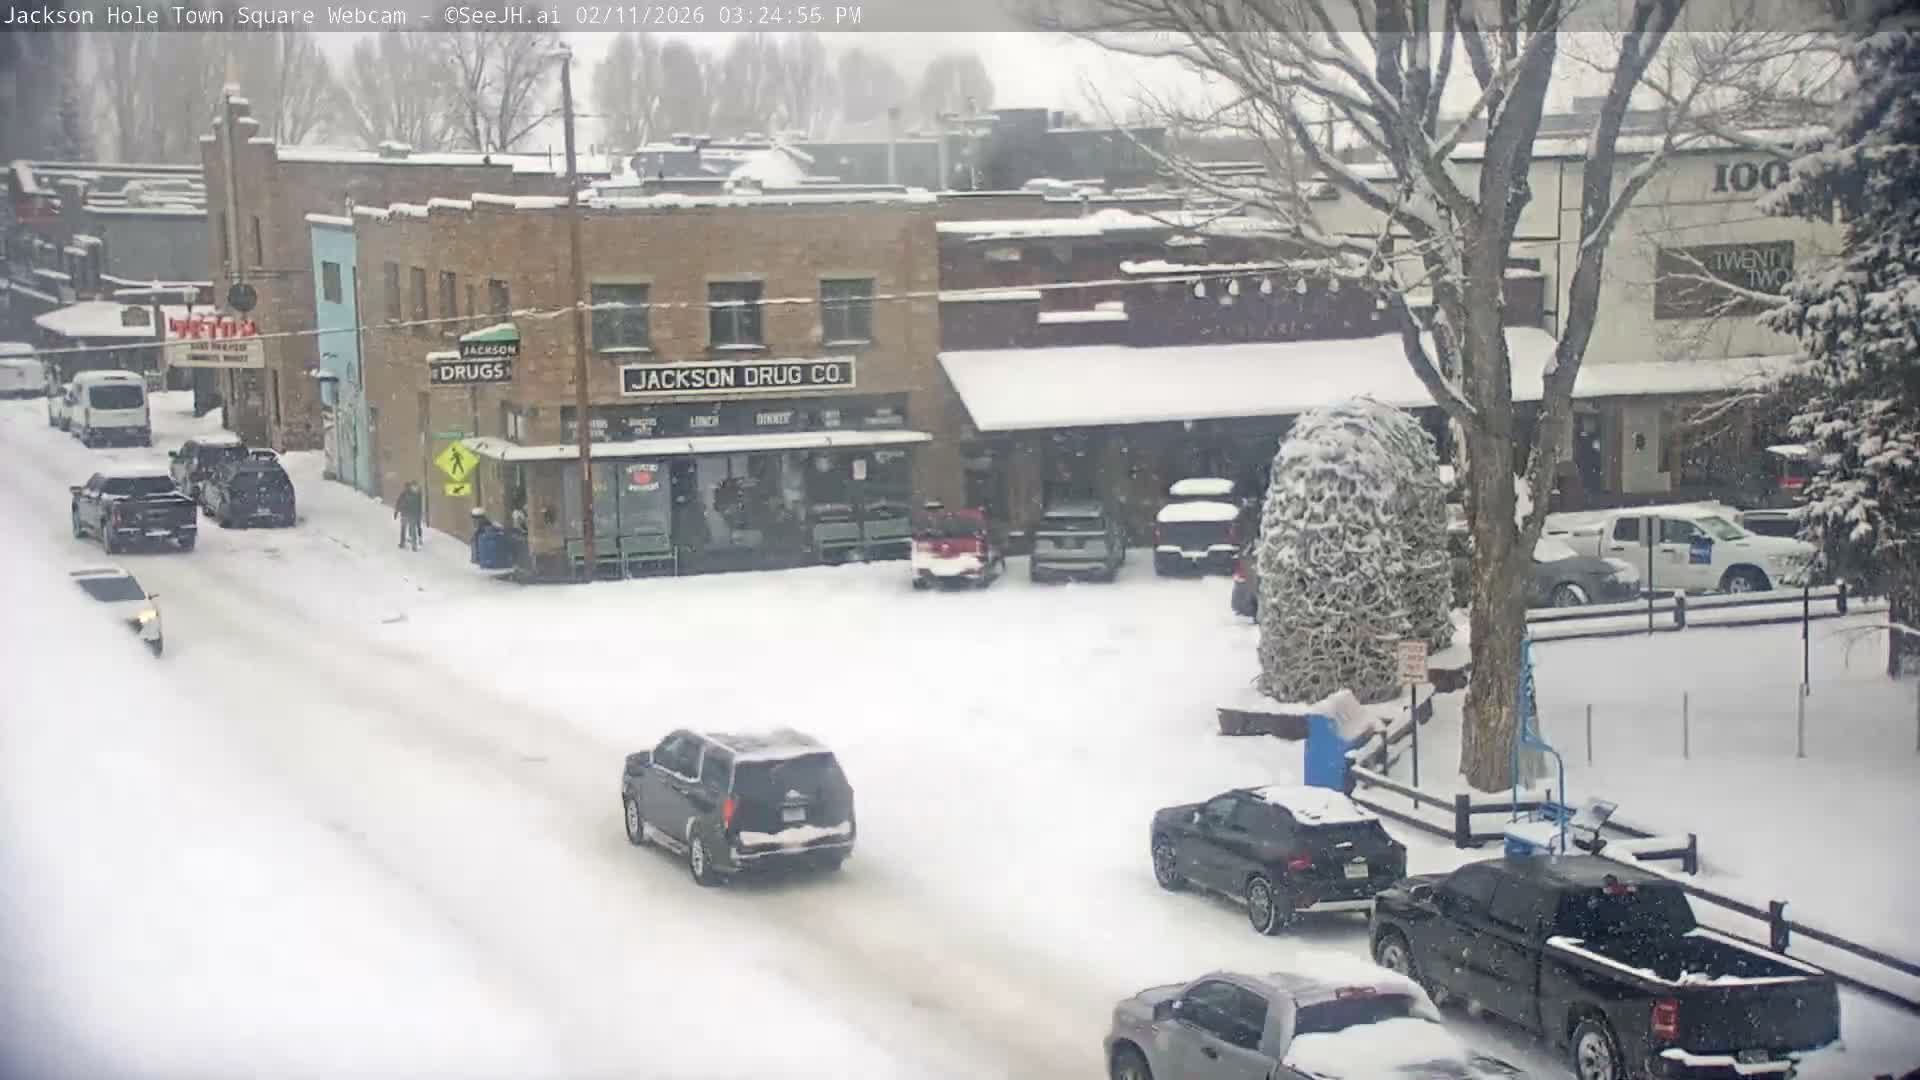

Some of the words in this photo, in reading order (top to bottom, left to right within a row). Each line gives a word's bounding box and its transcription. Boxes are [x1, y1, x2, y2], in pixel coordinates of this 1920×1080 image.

[1714, 250, 1788, 271] TWENTY
[1747, 267, 1790, 288] TWO
[463, 344, 517, 356] JACKSON
[440, 363, 504, 381] DRUGS
[631, 367, 735, 390] JACKSON
[743, 364, 802, 386] DRUG
[811, 363, 846, 384] CO.
